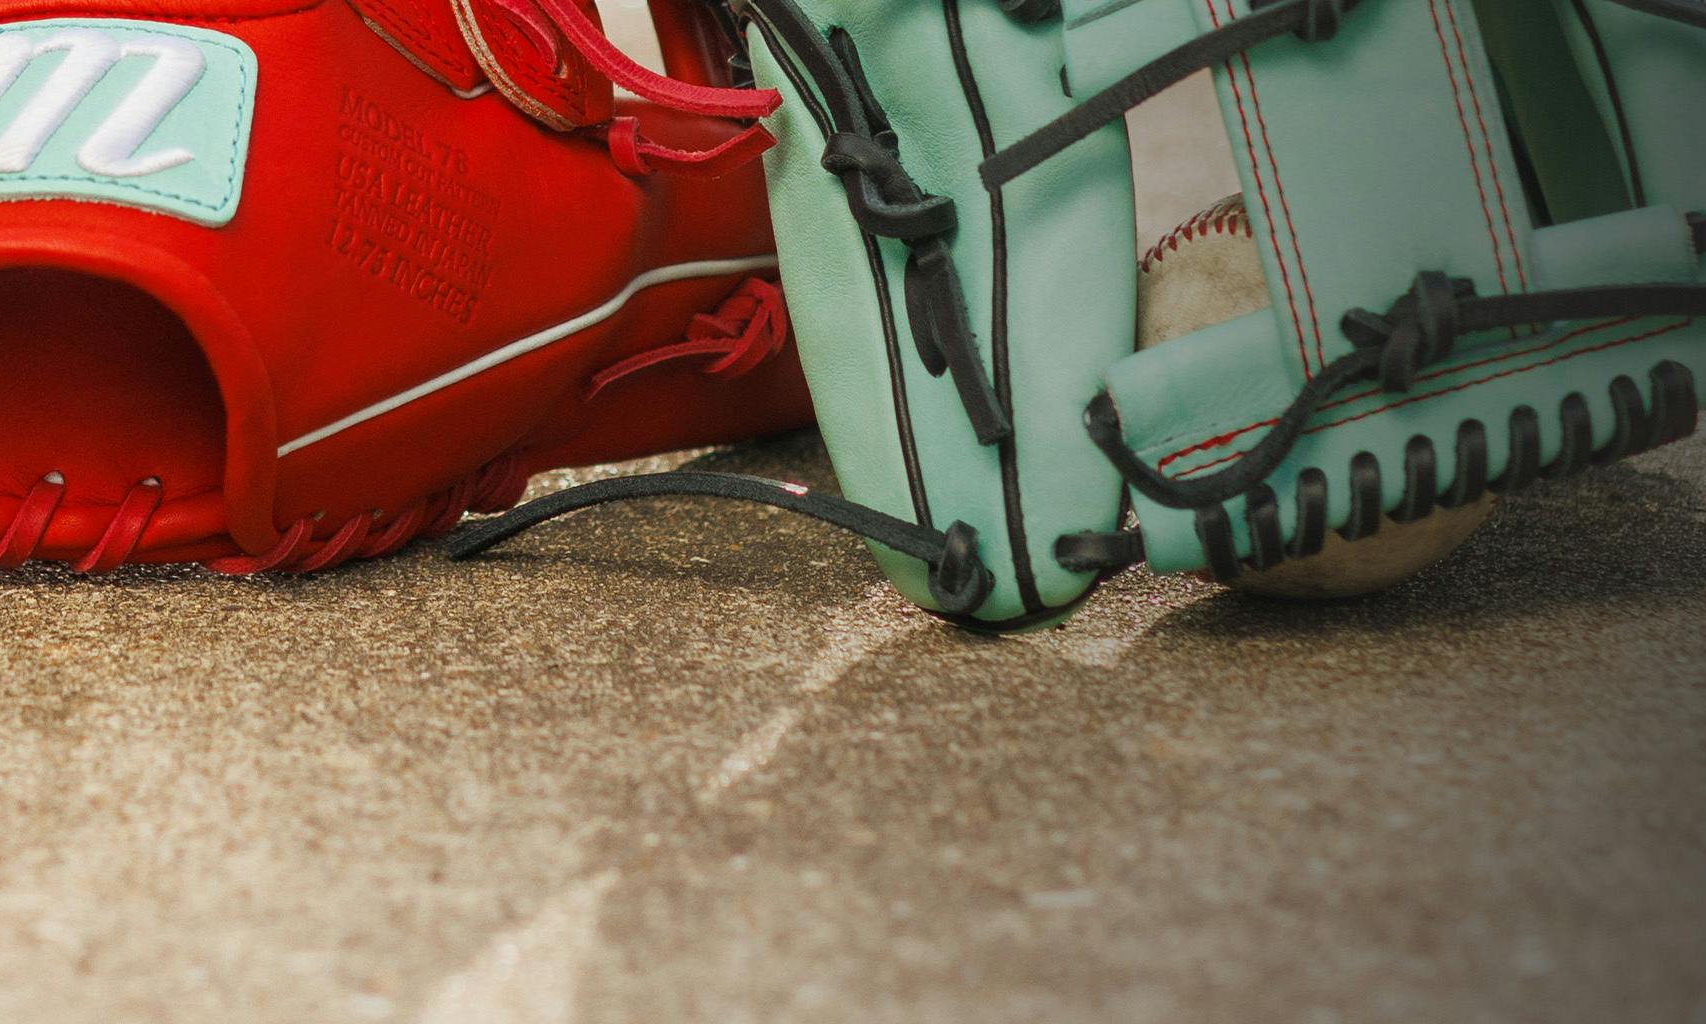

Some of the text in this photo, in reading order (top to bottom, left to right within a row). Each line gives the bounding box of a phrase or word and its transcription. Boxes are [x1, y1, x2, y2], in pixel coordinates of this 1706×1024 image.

[337, 122, 499, 216] CUSTOM CUT PATTERN
[339, 86, 431, 159] MODEL
[333, 186, 409, 243] TANNED
[430, 240, 490, 291] JAPAN
[336, 153, 492, 255] USA LEATHER
[388, 255, 477, 326] INCHES
